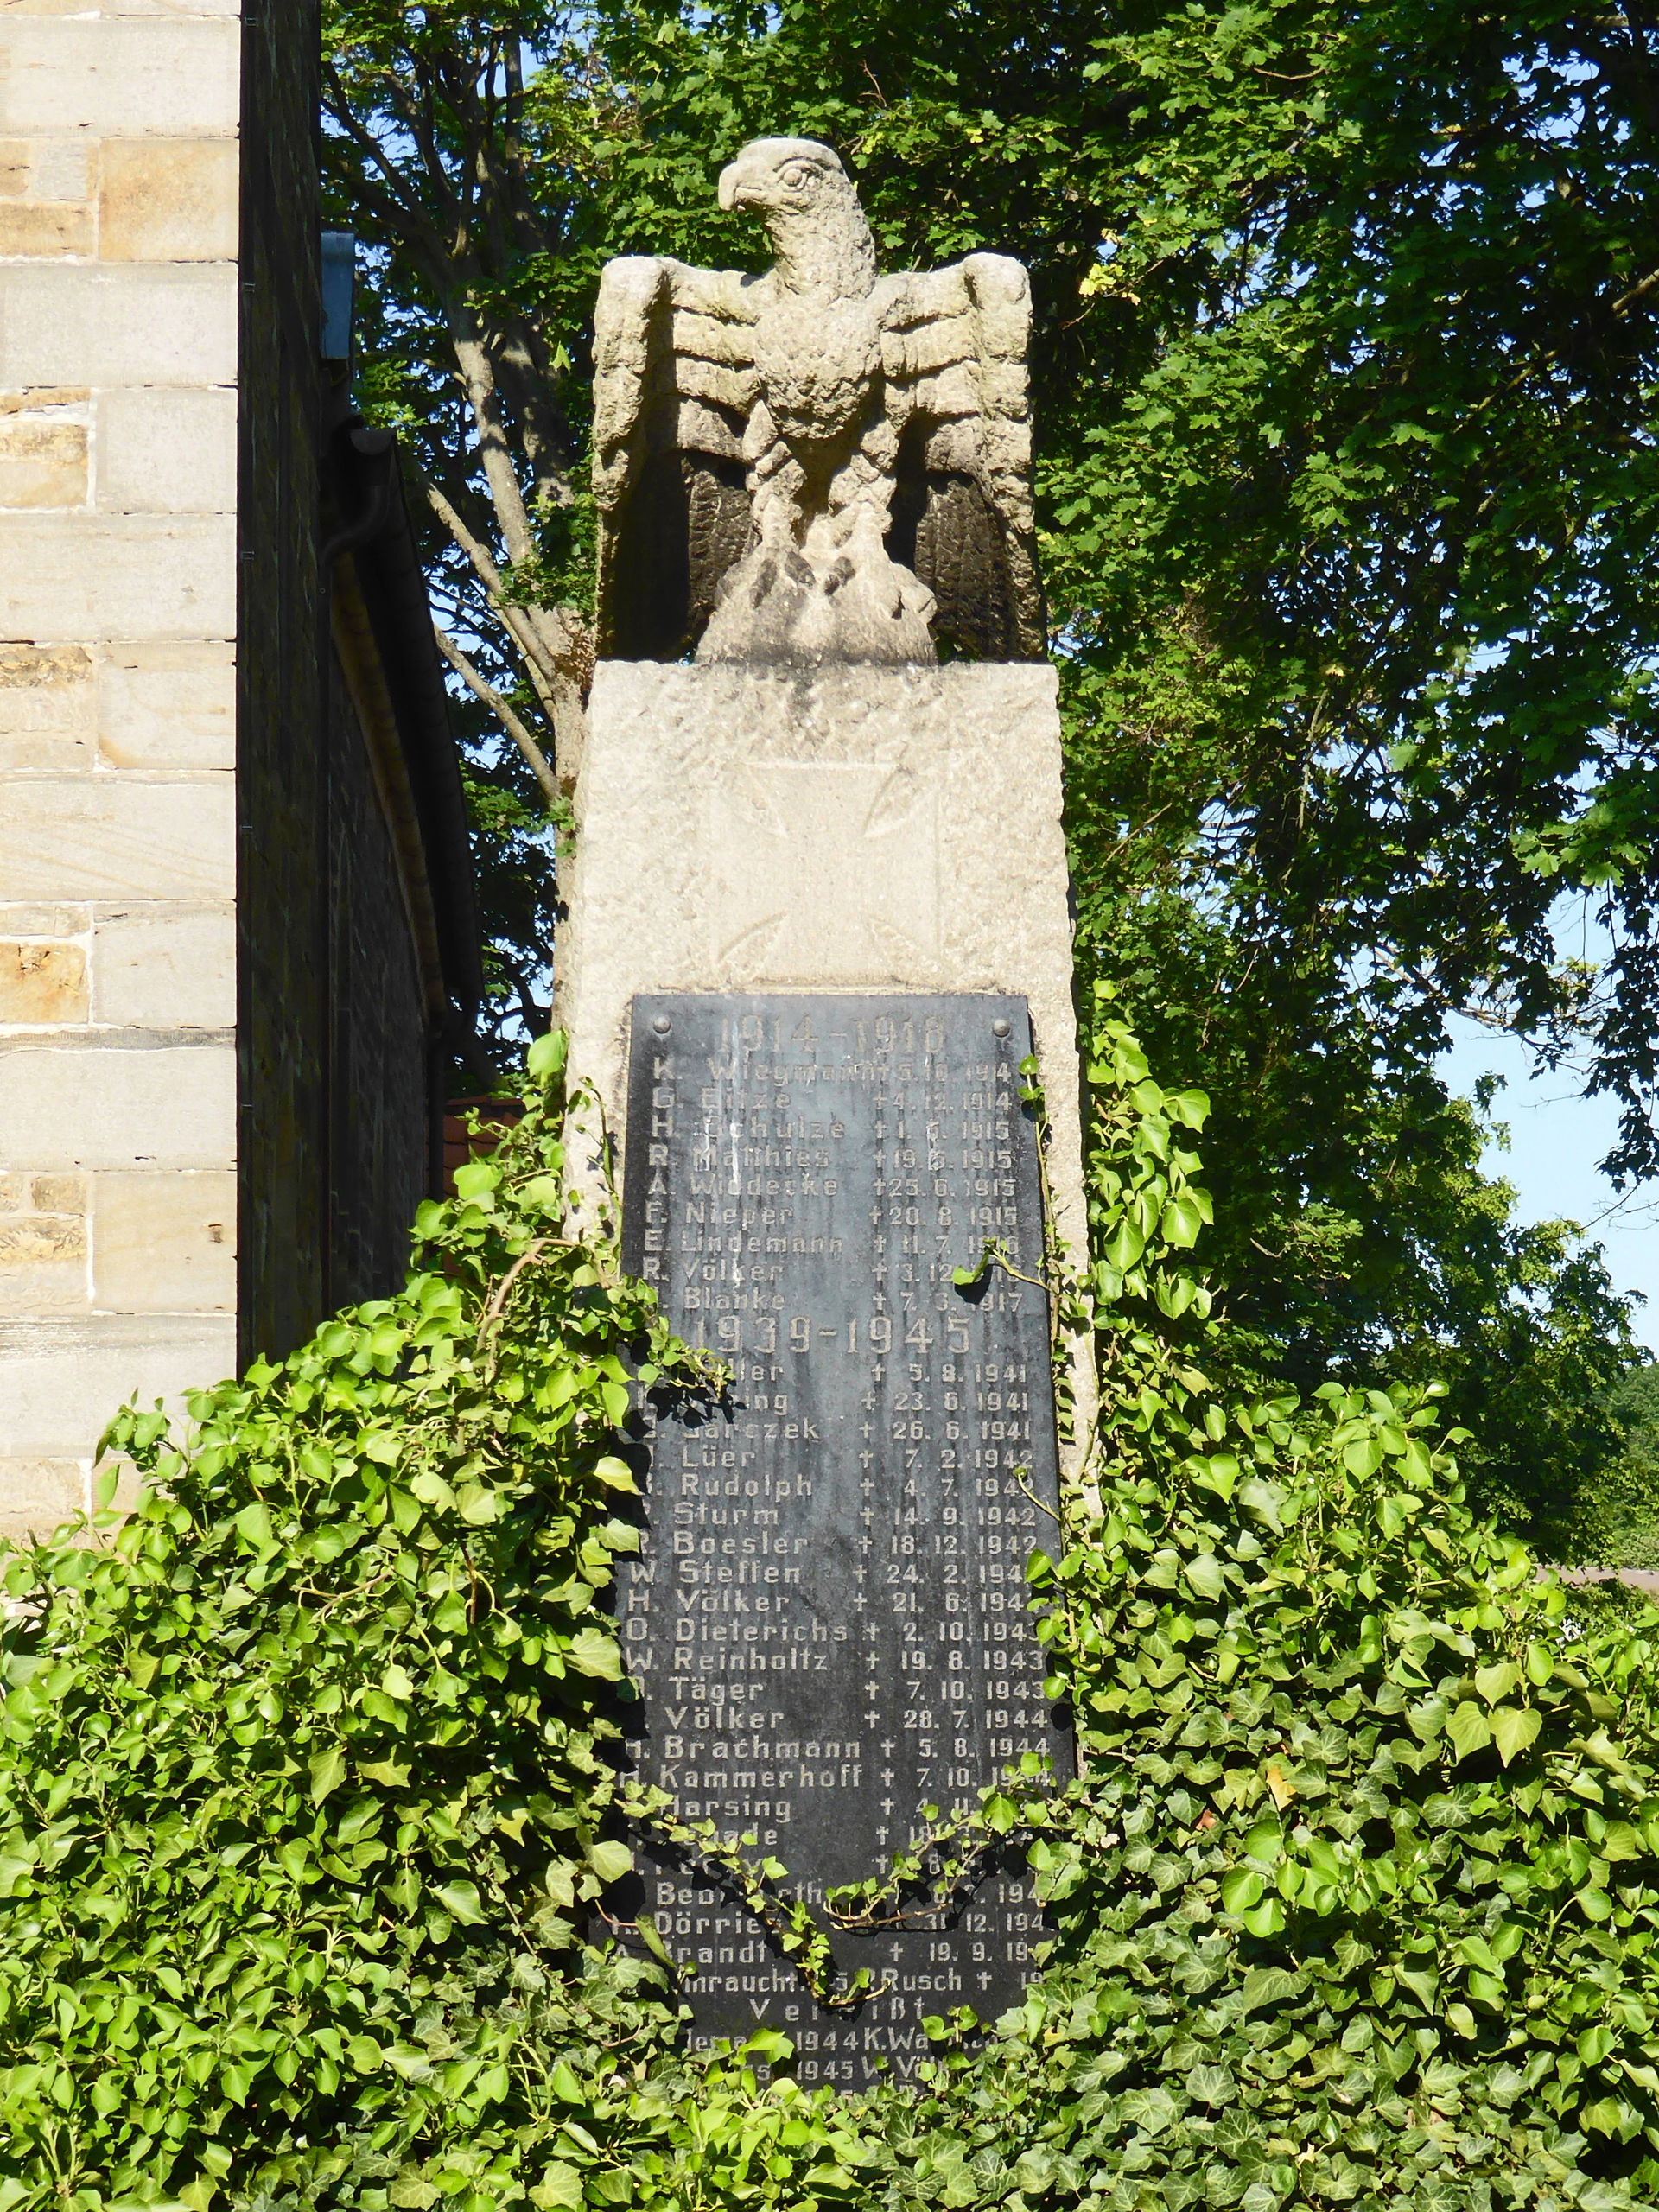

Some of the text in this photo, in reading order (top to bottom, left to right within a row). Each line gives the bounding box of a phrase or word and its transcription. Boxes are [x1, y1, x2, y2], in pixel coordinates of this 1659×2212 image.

[653, 1057, 683, 1080] K.
[707, 1057, 875, 1087] Wiegmann
[652, 1087, 683, 1109] G.
[963, 1091, 1012, 1111] 1914
[963, 1121, 1010, 1140] 1915
[649, 1143, 678, 1166] R.
[963, 1149, 1012, 1169] 1915
[648, 1173, 677, 1195] A.
[888, 1179, 927, 1198] 25.
[964, 1179, 1016, 1198] 1915
[685, 1200, 794, 1230] Nieper
[889, 1206, 926, 1225] 20.
[969, 1206, 1017, 1226] 1915
[645, 1229, 671, 1251] E.
[681, 1230, 844, 1253] Lindemann
[683, 1257, 784, 1281] Völker
[684, 1287, 785, 1310] Blanke
[971, 1292, 1023, 1312] 917
[695, 1314, 970, 1355] 1939-1945
[976, 1363, 1026, 1382] 1941
[894, 1392, 931, 1411] 23.
[977, 1392, 1028, 1411] 1941
[893, 1421, 931, 1440] 26.
[982, 1421, 1030, 1441] 1941
[683, 1444, 756, 1467] Lüer
[976, 1449, 1033, 1469] 1942
[681, 1471, 812, 1503] Rudolph
[674, 1501, 779, 1525] Sturm
[978, 1507, 1036, 1527] 1942
[673, 1530, 808, 1554] Boesler
[892, 1535, 923, 1554] 18.
[935, 1535, 966, 1554] 12.
[979, 1535, 1037, 1555] 1942
[678, 1559, 802, 1584] Steffen
[887, 1564, 925, 1584] 24.
[980, 1564, 1025, 1584] 194
[628, 1588, 659, 1612] H.
[676, 1588, 789, 1612] Völker
[981, 1592, 1027, 1612] 194
[676, 1617, 848, 1642] Dieterichs
[674, 1646, 828, 1670] Reinholtz
[901, 1650, 932, 1670] 19.
[983, 1650, 1044, 1670] 1943
[668, 1675, 764, 1707] Täger
[941, 1681, 973, 1700] 10.
[987, 1681, 1045, 1700] 1943
[664, 1705, 785, 1729] Völker
[904, 1709, 939, 1729] 28.
[986, 1709, 1048, 1729] 1944
[664, 1734, 860, 1759] Brachmann
[659, 1764, 862, 1789] Kammerhoff
[948, 1767, 977, 1787] 10.
[966, 1912, 995, 1933] 12.
[1007, 1912, 1044, 1931] 194
[930, 1942, 958, 1962] 19.
[881, 1967, 962, 1992] Rusch
[748, 1995, 925, 2021] Verißt
[796, 2031, 858, 2051] 1944
[796, 2060, 854, 2080] 1945
